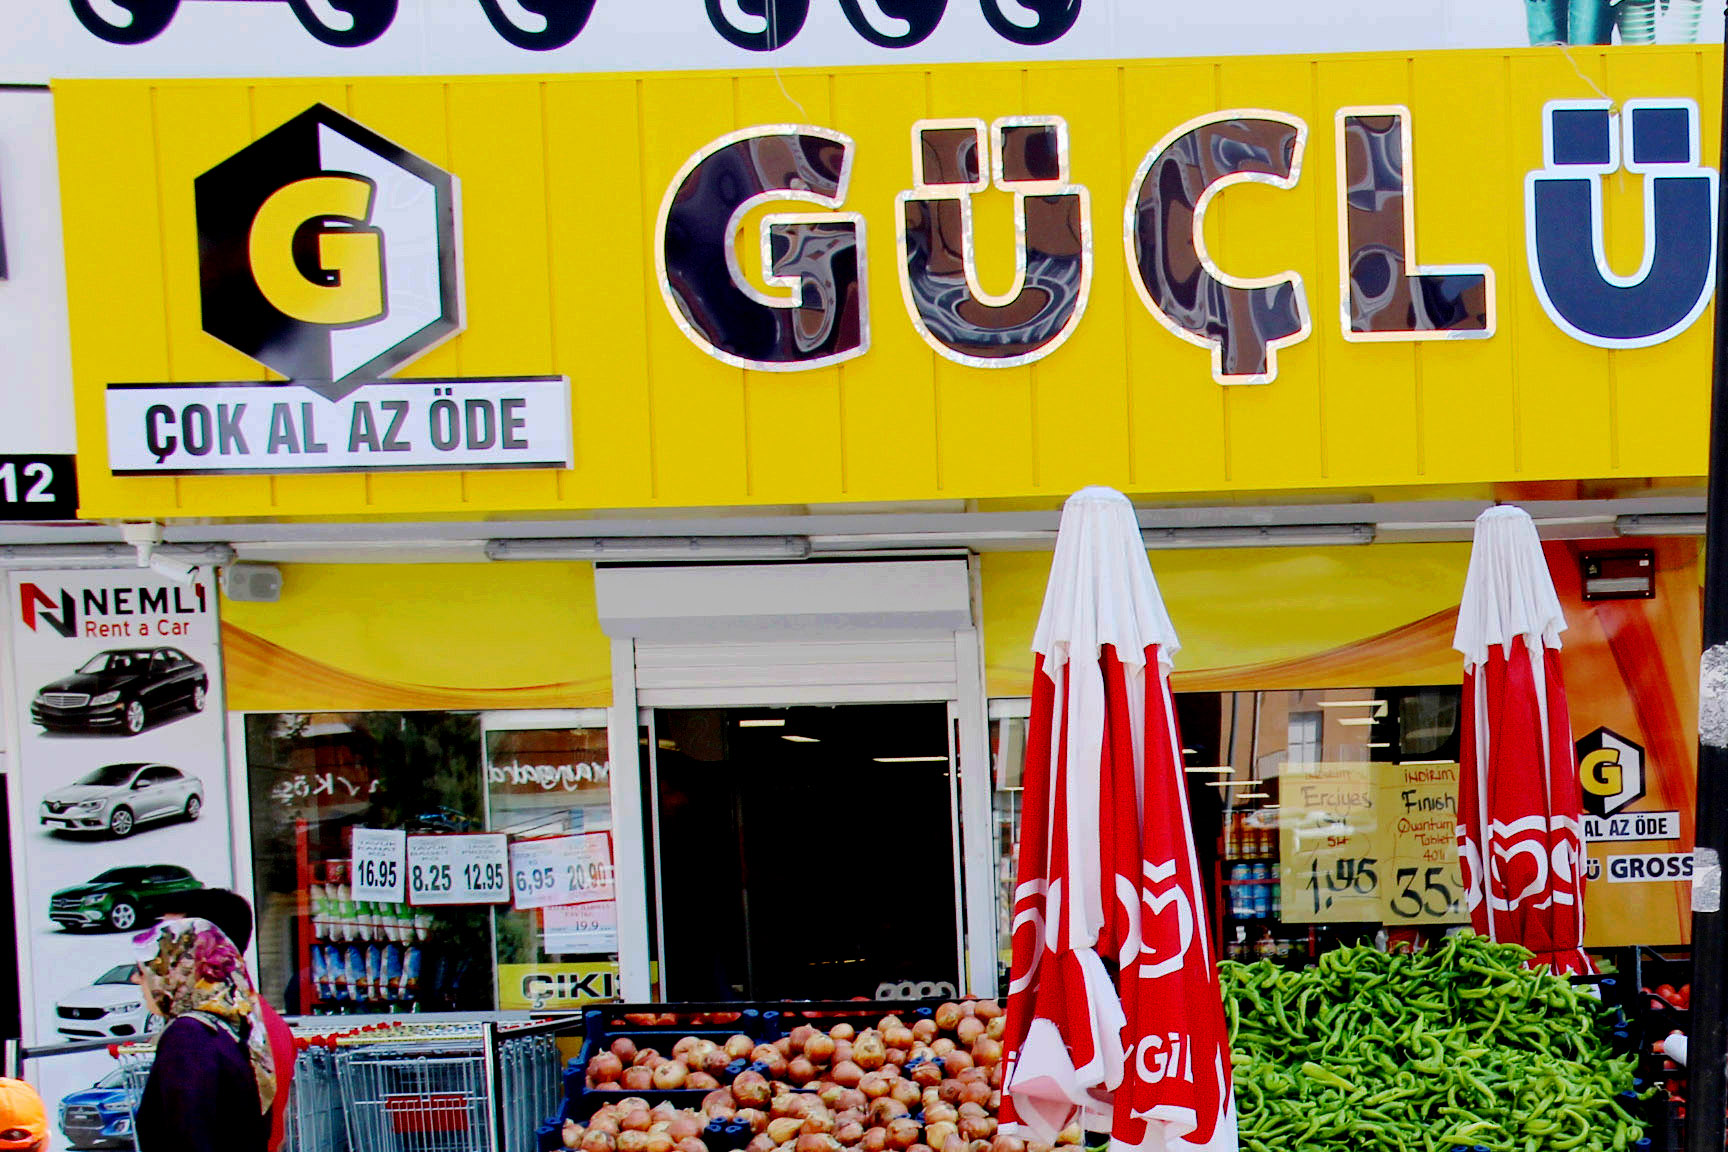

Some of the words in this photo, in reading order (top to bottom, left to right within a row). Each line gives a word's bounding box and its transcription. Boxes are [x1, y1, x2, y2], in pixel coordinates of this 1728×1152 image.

[654, 98, 1720, 386] GÜÇLÜ
[146, 403, 250, 463] ÇOK
[267, 402, 328, 454] AL
[348, 399, 411, 451] AZ
[429, 387, 528, 450] ÖDE
[85, 621, 130, 637] Rent
[139, 624, 149, 636] a
[157, 619, 190, 635] Car
[1585, 820, 1603, 837] AL
[1610, 819, 1629, 835] AZ
[1635, 815, 1668, 835] ÖDE
[358, 859, 397, 888] 16.95
[412, 864, 452, 892] 8.25
[463, 863, 504, 890] 12.95
[516, 867, 556, 895] 6,95
[1611, 856, 1693, 878] GROSS
